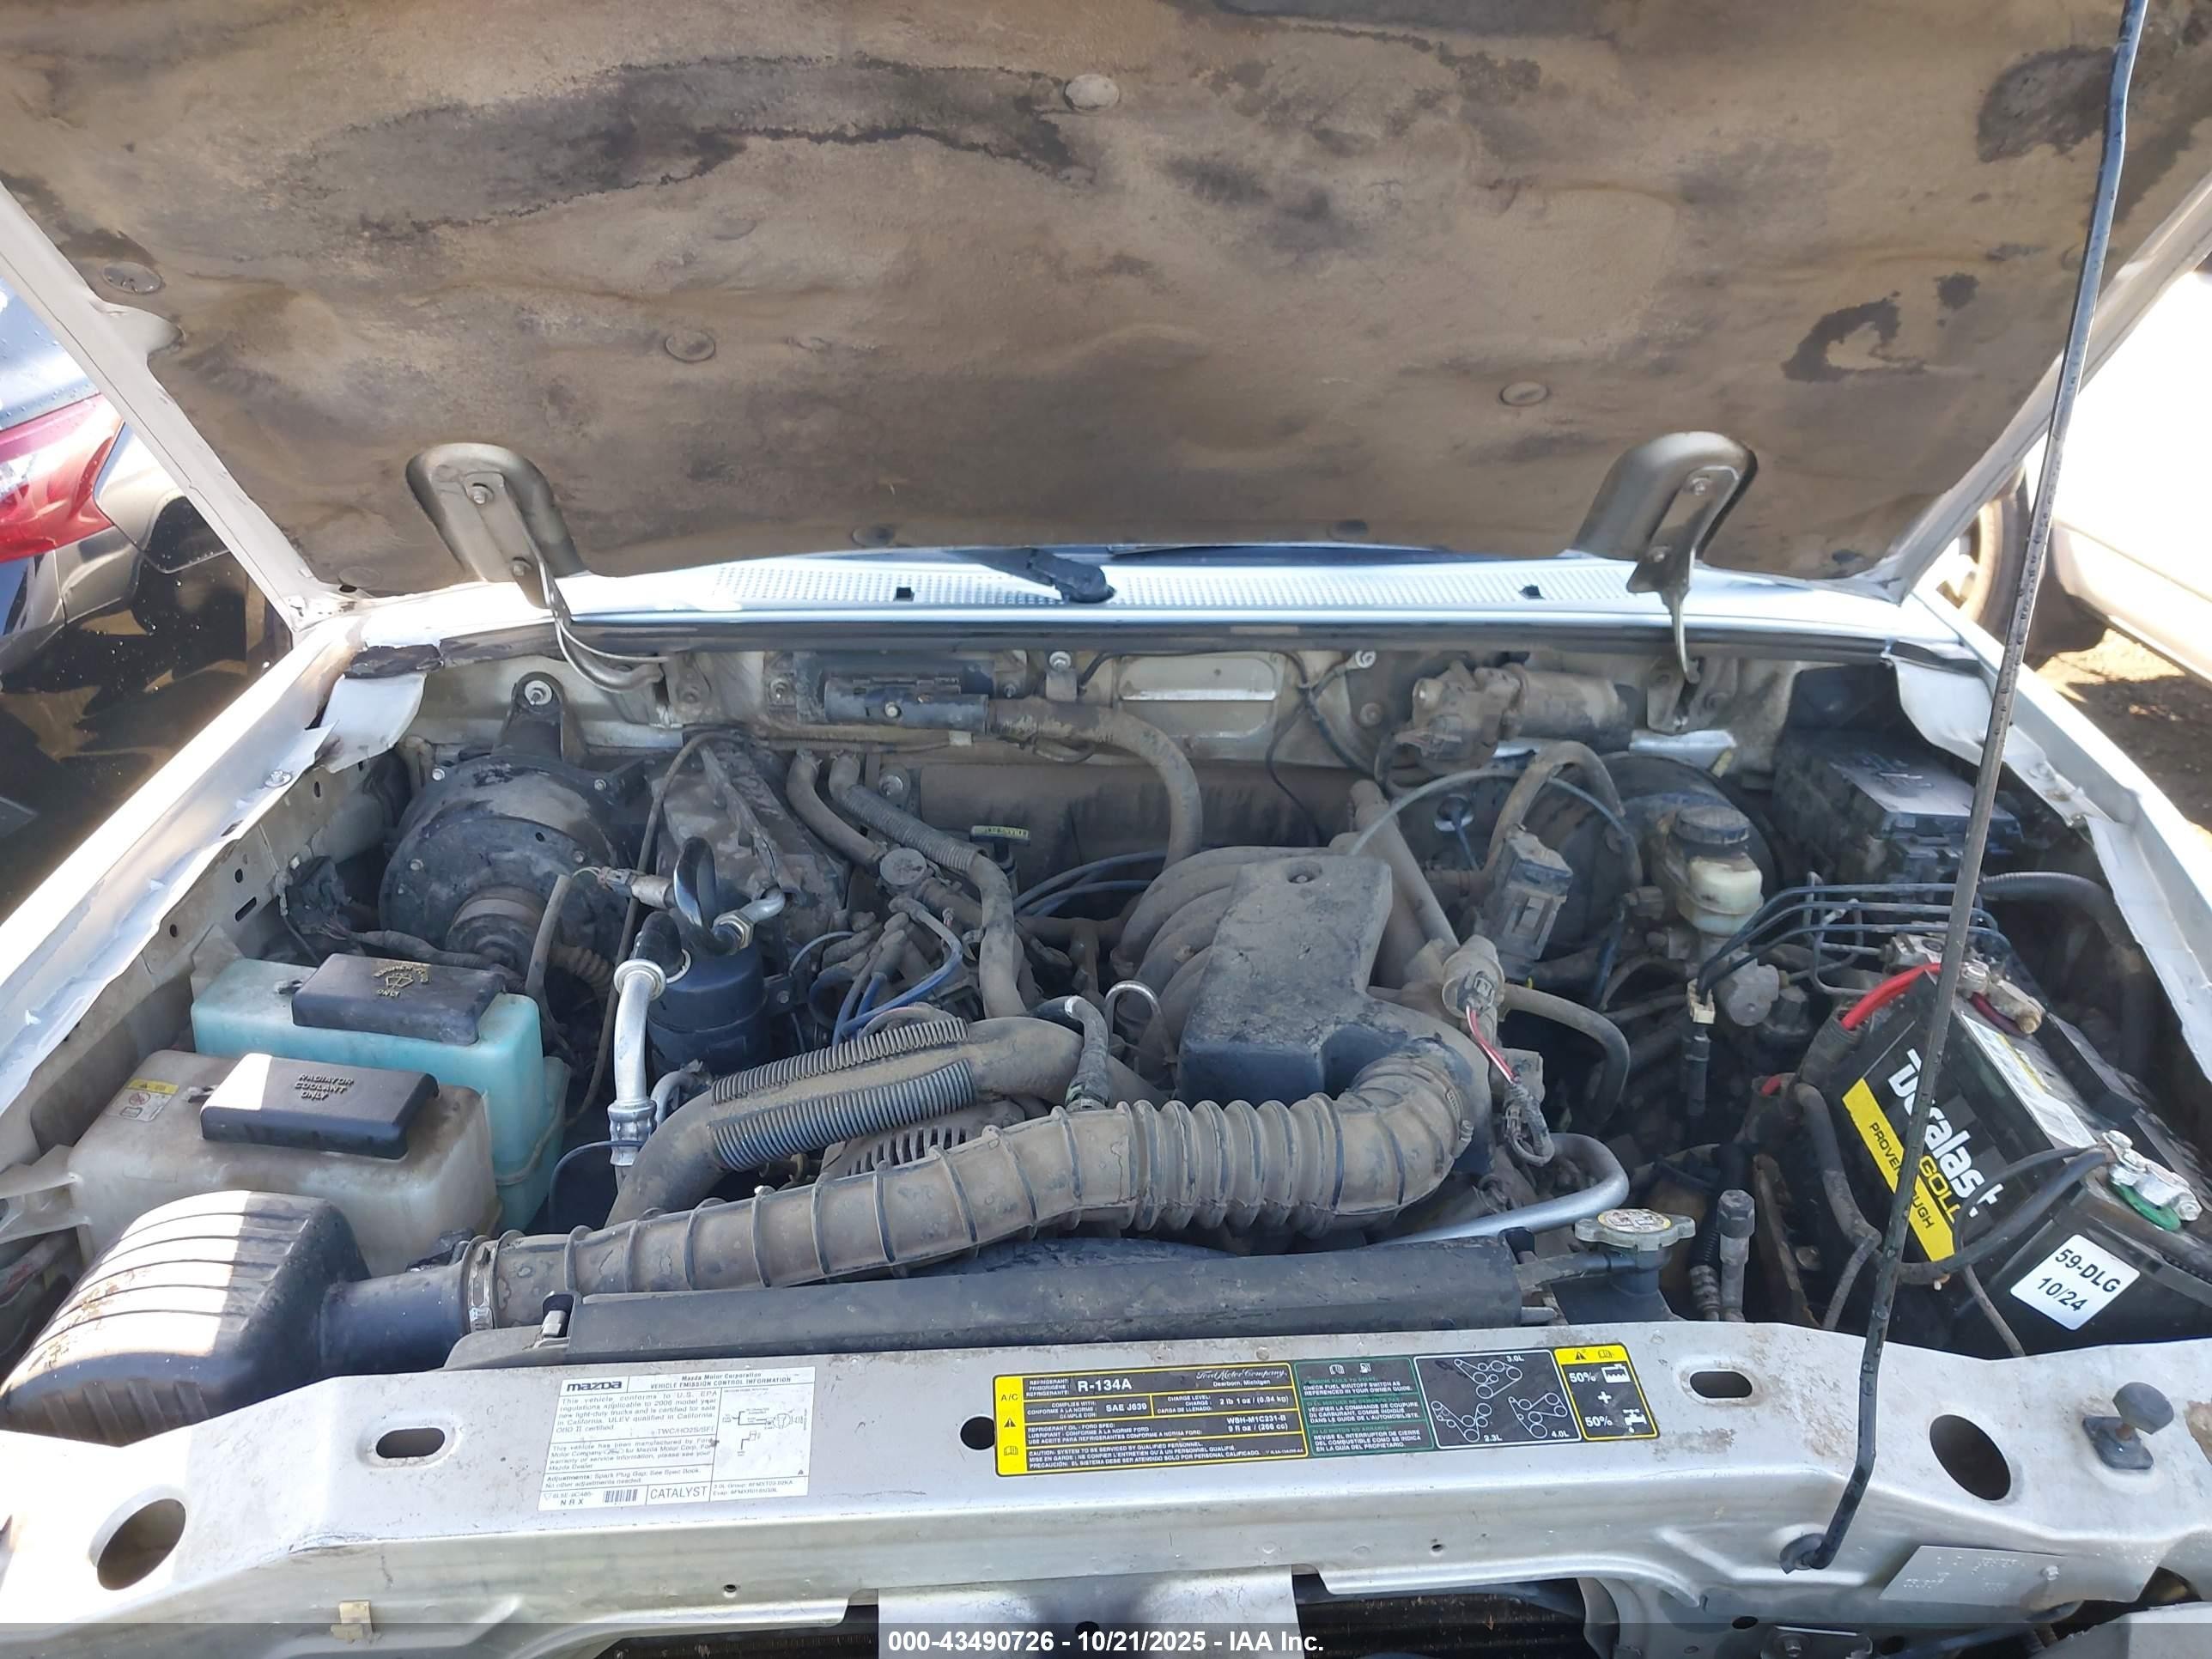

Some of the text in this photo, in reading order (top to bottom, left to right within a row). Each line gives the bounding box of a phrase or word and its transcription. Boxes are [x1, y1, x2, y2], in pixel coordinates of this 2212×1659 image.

[299, 1073, 354, 1085] RADIATOR
[295, 1082, 347, 1094] COOLANT
[301, 1091, 329, 1101] ONLY
[2055, 1249, 2121, 1292] 59-DLG
[2037, 1278, 2088, 1311] 10/24
[746, 1376, 791, 1385] INFORMATION
[1569, 1372, 1596, 1382] 50%
[1077, 1378, 1132, 1391] R-134A
[1585, 1417, 1613, 1426] 50%
[650, 1486, 708, 1500] CATALYST
